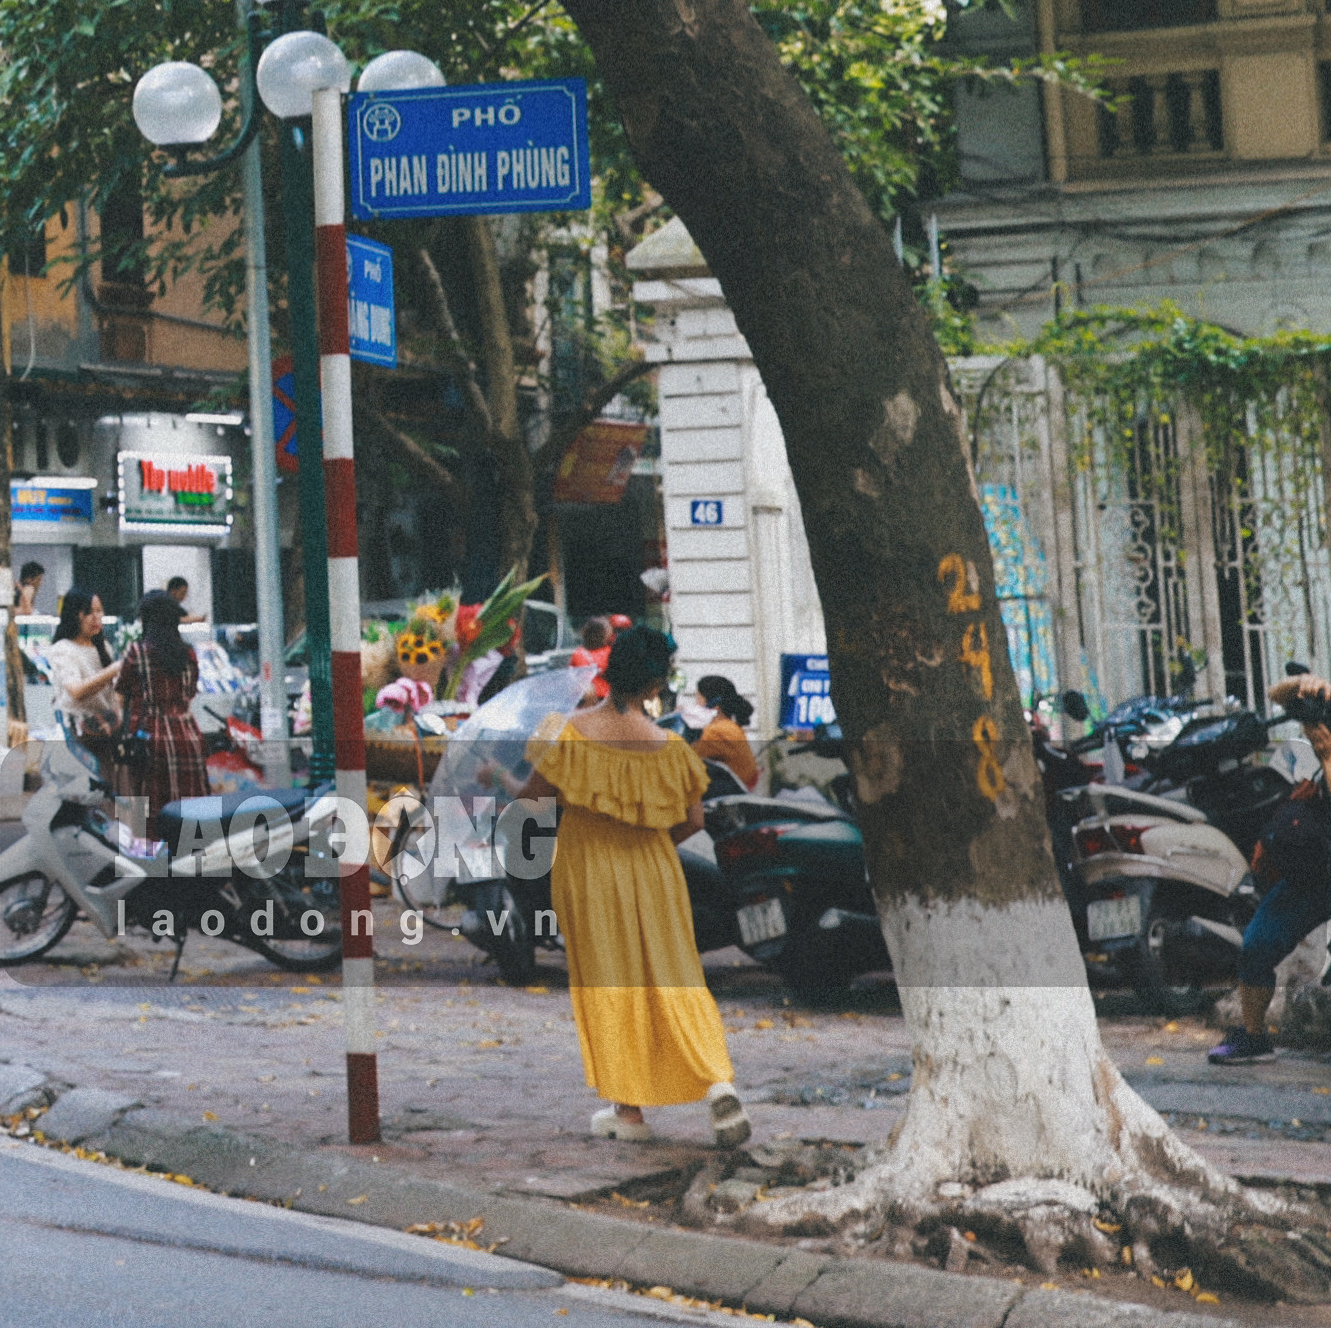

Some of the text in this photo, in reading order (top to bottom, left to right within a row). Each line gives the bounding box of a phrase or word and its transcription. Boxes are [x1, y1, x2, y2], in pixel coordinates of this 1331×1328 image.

[451, 94, 522, 129] PHỐ
[370, 139, 571, 198] PHAN ĐÌNH PHÙNG
[694, 502, 719, 523] 46
